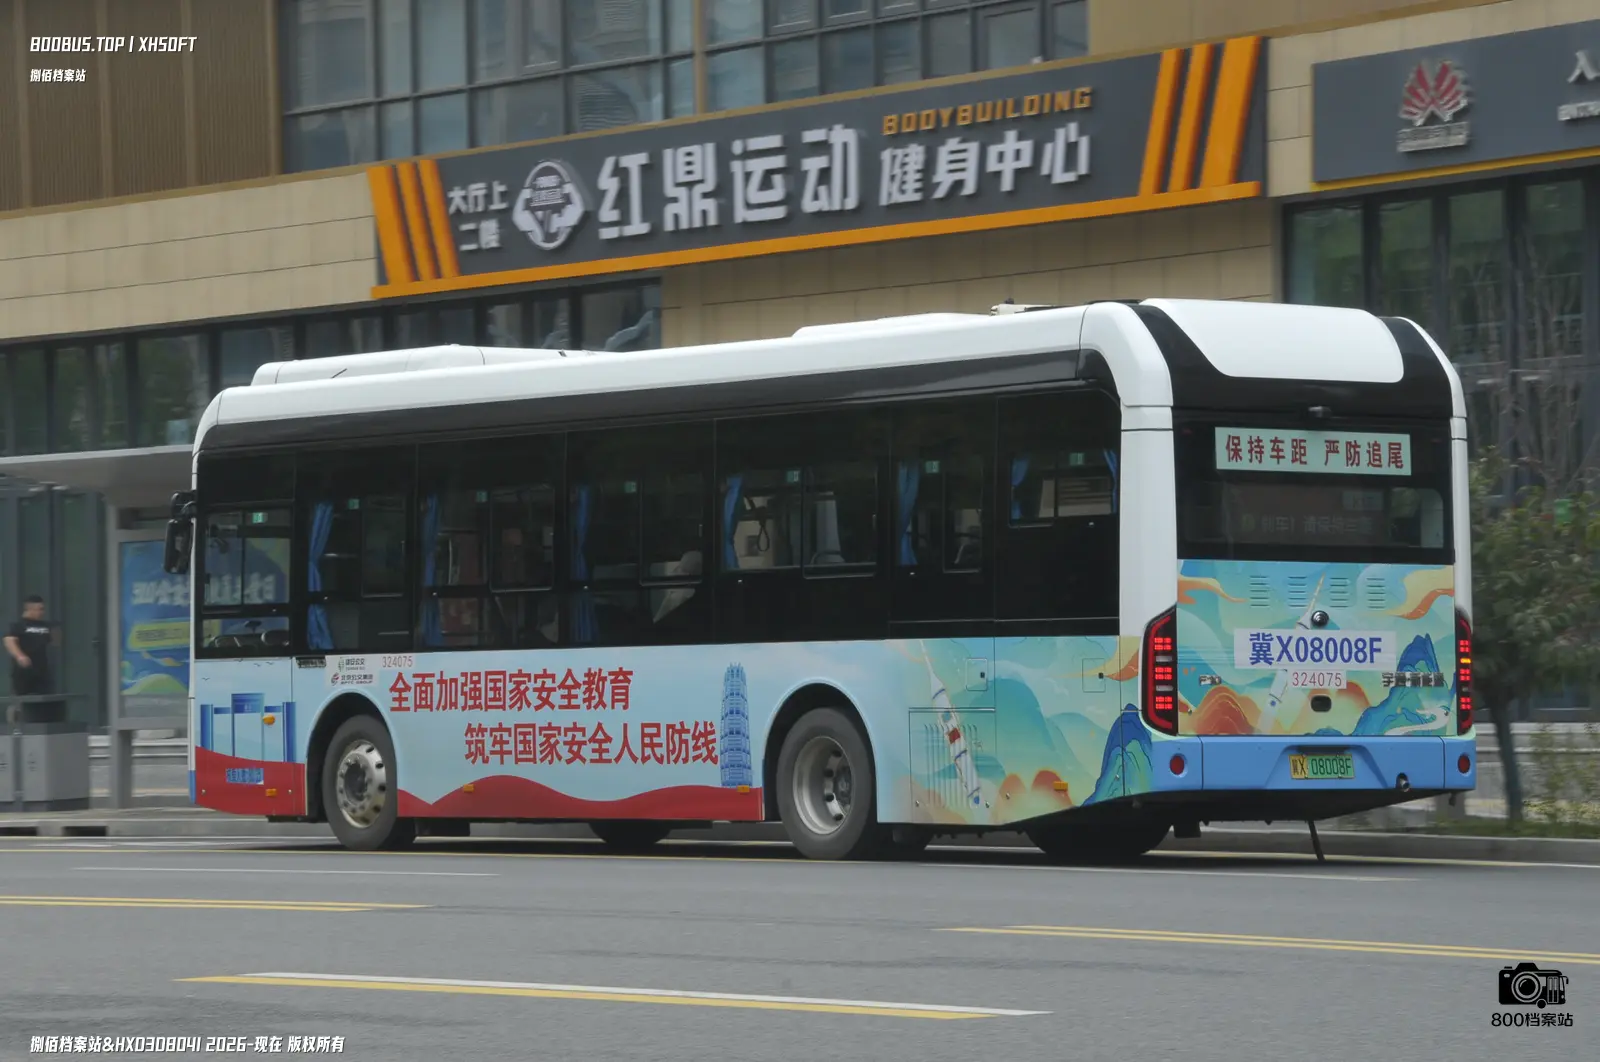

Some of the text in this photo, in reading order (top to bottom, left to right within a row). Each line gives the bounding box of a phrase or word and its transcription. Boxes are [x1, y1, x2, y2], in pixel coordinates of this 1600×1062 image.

[882, 86, 1092, 136] BODYBUILDING
[597, 122, 1091, 240] 红鼎运动 健身中心
[1225, 434, 1404, 470] 保持车距 严防追尾
[382, 656, 413, 668] 324075
[1249, 632, 1383, 666] 冀X08008F
[389, 667, 634, 713] 全面加强国家安全教育
[1292, 671, 1343, 688] 324075
[464, 720, 719, 766] 筑牢国家安全人民防线
